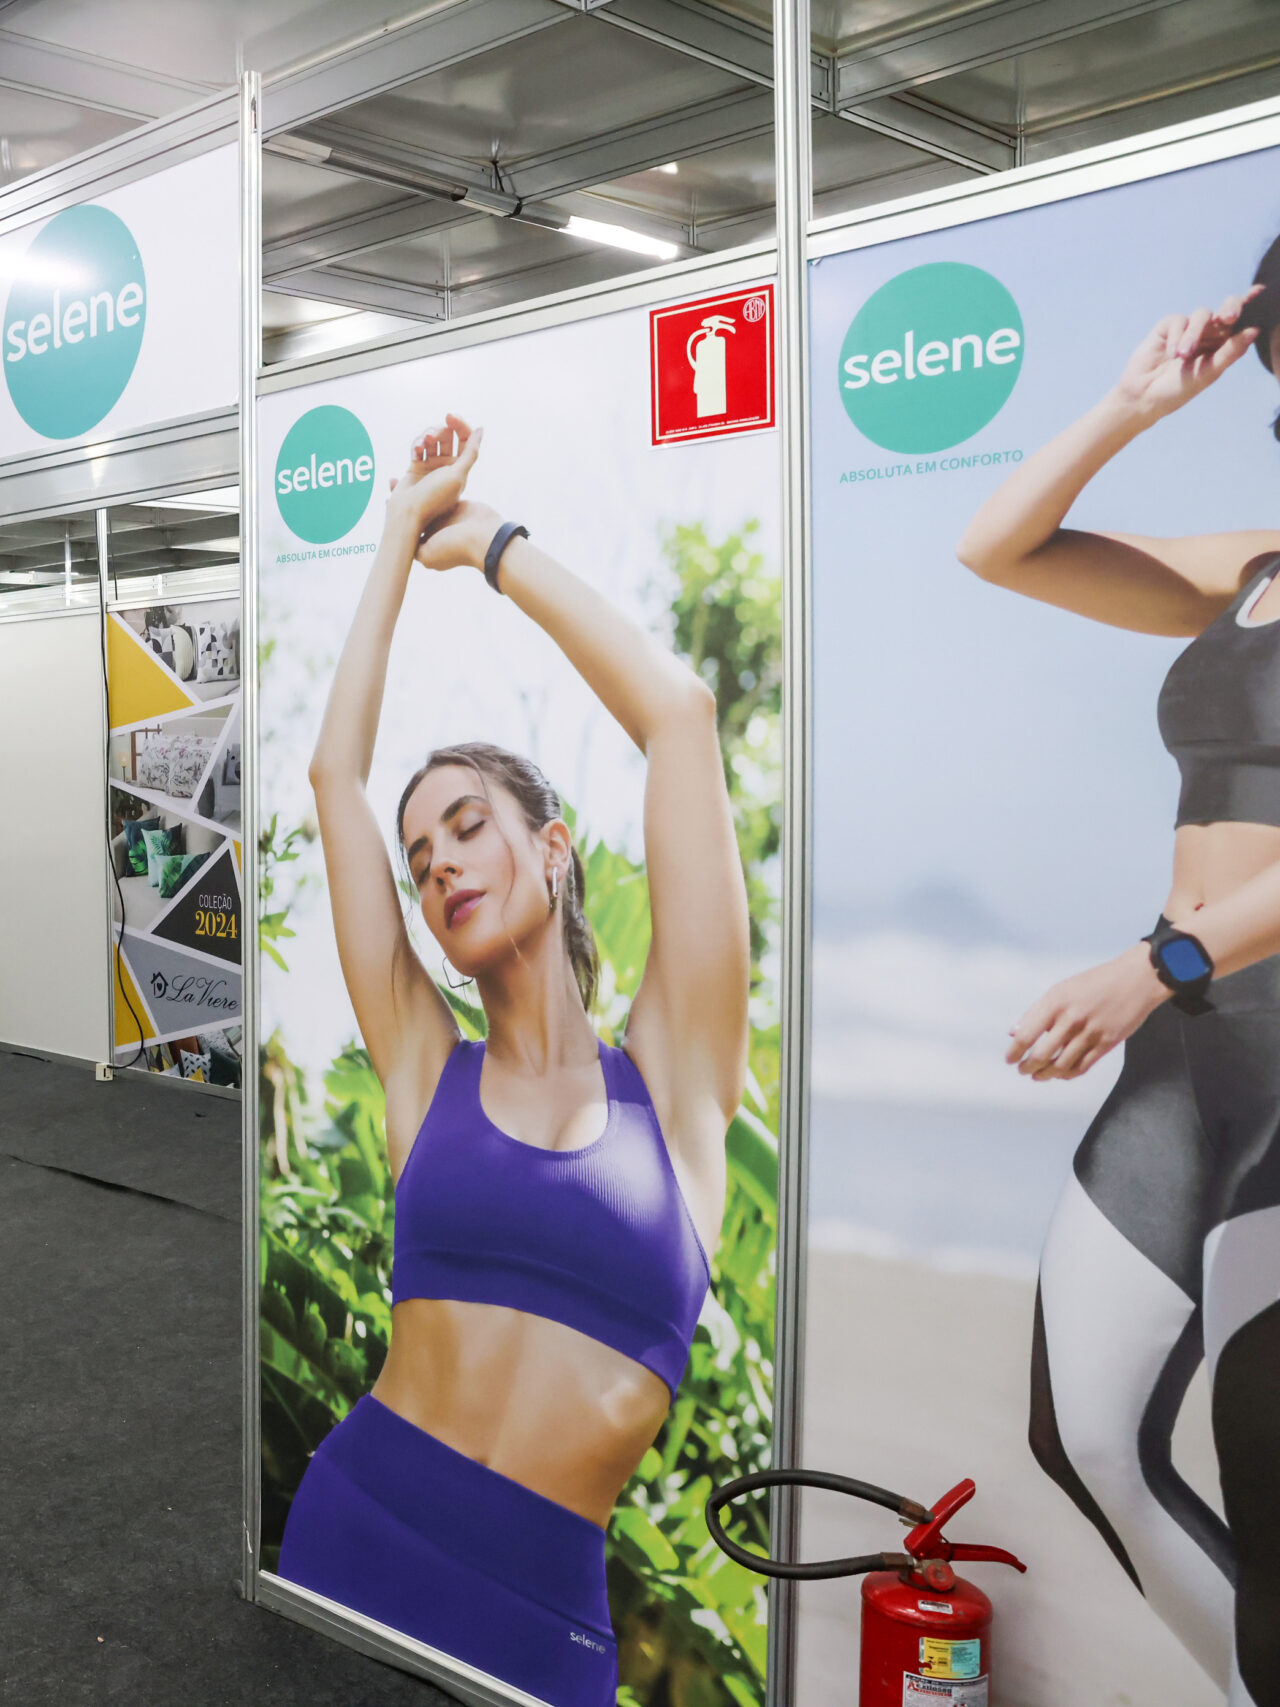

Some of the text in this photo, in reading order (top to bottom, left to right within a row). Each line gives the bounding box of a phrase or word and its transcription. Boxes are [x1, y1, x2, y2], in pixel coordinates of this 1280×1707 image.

[6, 282, 144, 362] selene
[843, 327, 1021, 390] selene
[277, 452, 374, 495] selene
[839, 449, 1024, 484] ABSOLUTA EM CONFORTO
[275, 543, 377, 563] ABSOLUTA EM CONFORTO
[198, 893, 233, 912] COLEÇÃO
[195, 911, 238, 939] 2024
[166, 975, 195, 1003] La
[569, 1631, 606, 1654] selene
